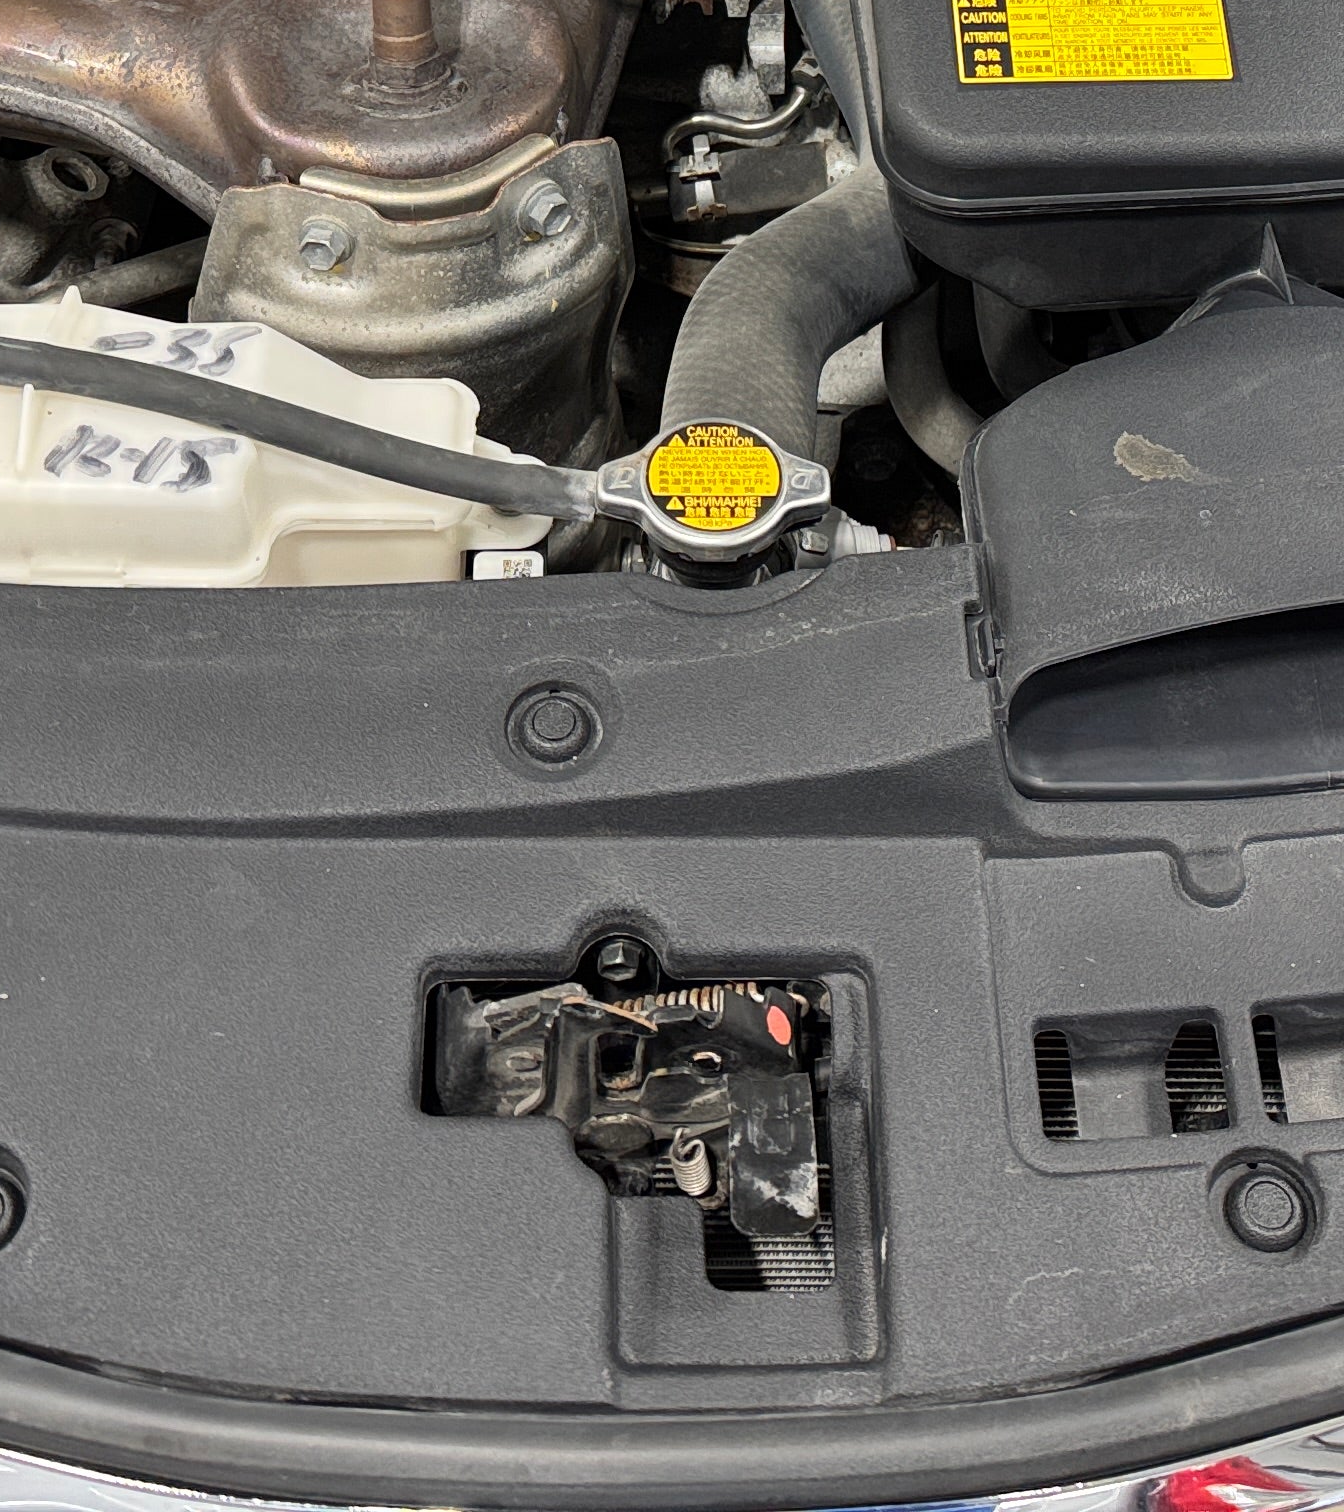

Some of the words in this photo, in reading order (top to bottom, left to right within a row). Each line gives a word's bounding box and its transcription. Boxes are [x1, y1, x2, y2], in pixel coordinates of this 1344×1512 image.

[961, 12, 1006, 24] CAUTION
[963, 31, 1008, 44] ATTENTION
[686, 426, 738, 437] CAUTION
[687, 436, 754, 446] ATTENTION
[684, 496, 762, 507] ВНИМАНИЕ!
